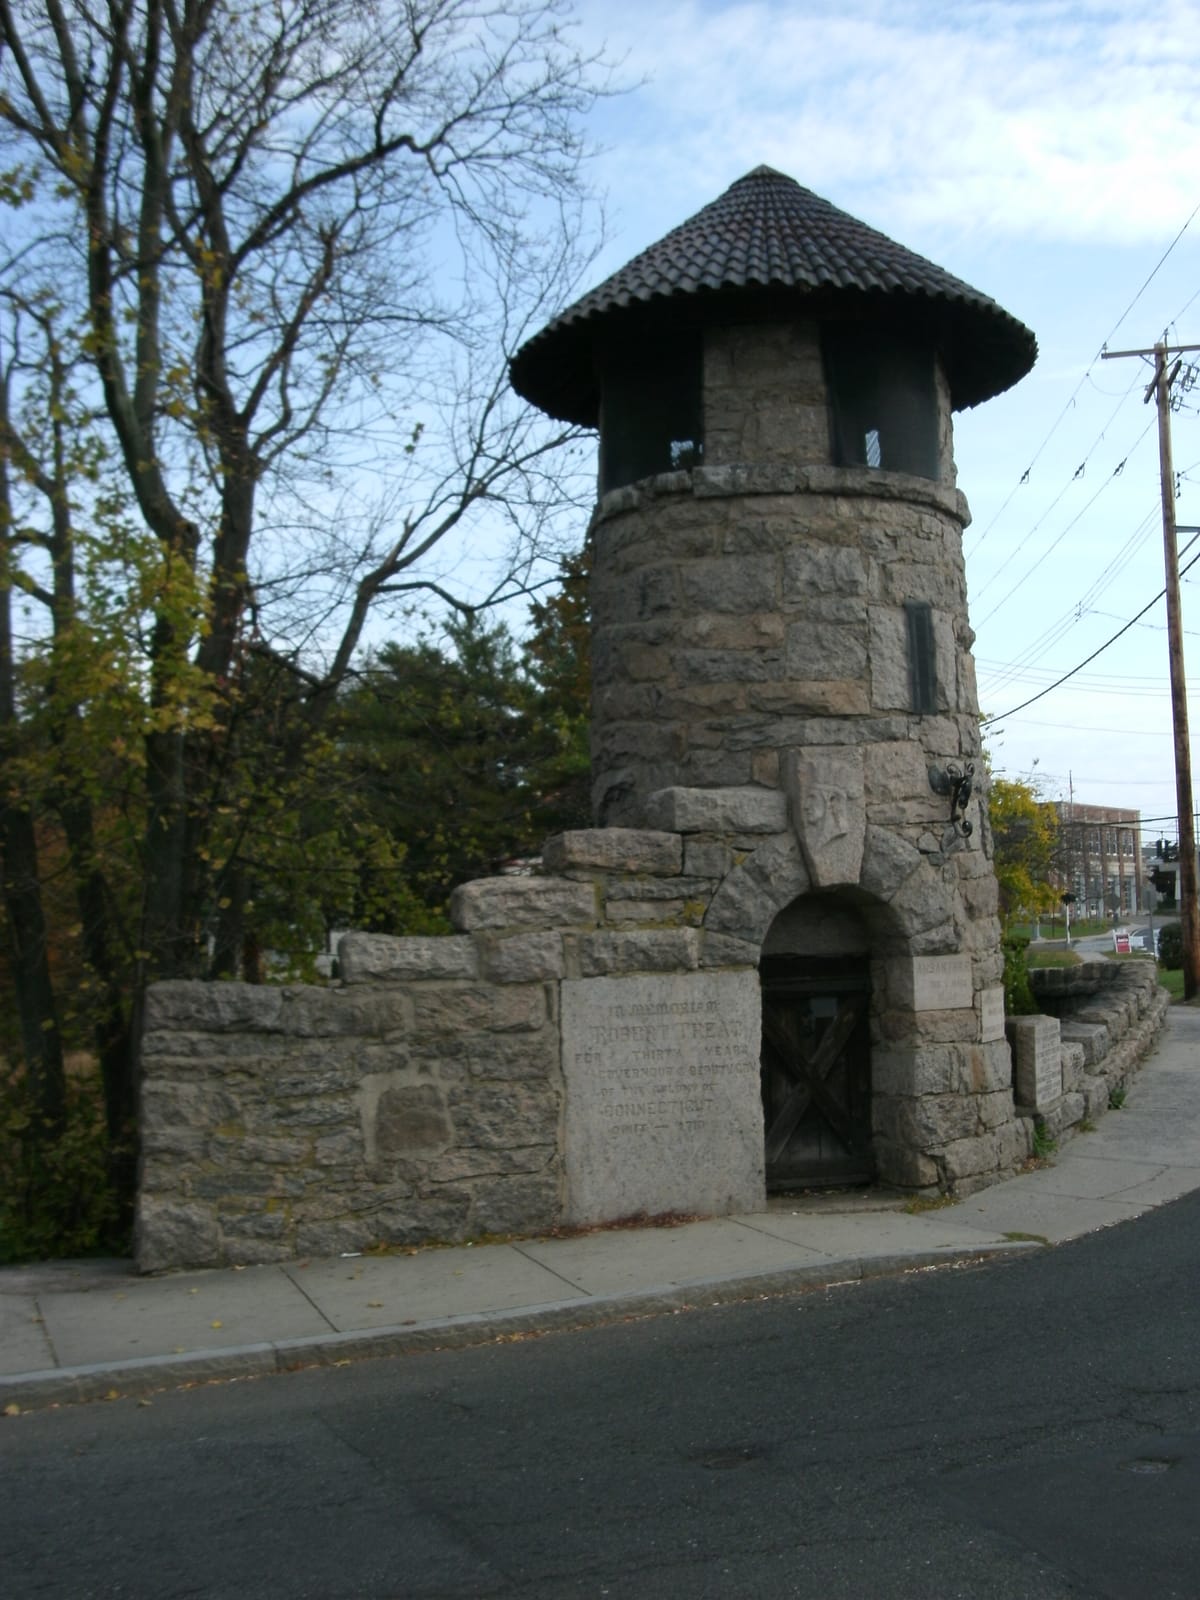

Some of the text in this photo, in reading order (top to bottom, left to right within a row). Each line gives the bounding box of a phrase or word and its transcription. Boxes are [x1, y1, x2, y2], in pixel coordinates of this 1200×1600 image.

[590, 1020, 743, 1044] ROBERT TREAT
[575, 1046, 748, 1064] FOR THIRTY YEARS
[603, 1099, 714, 1118] CONNECTICUT
